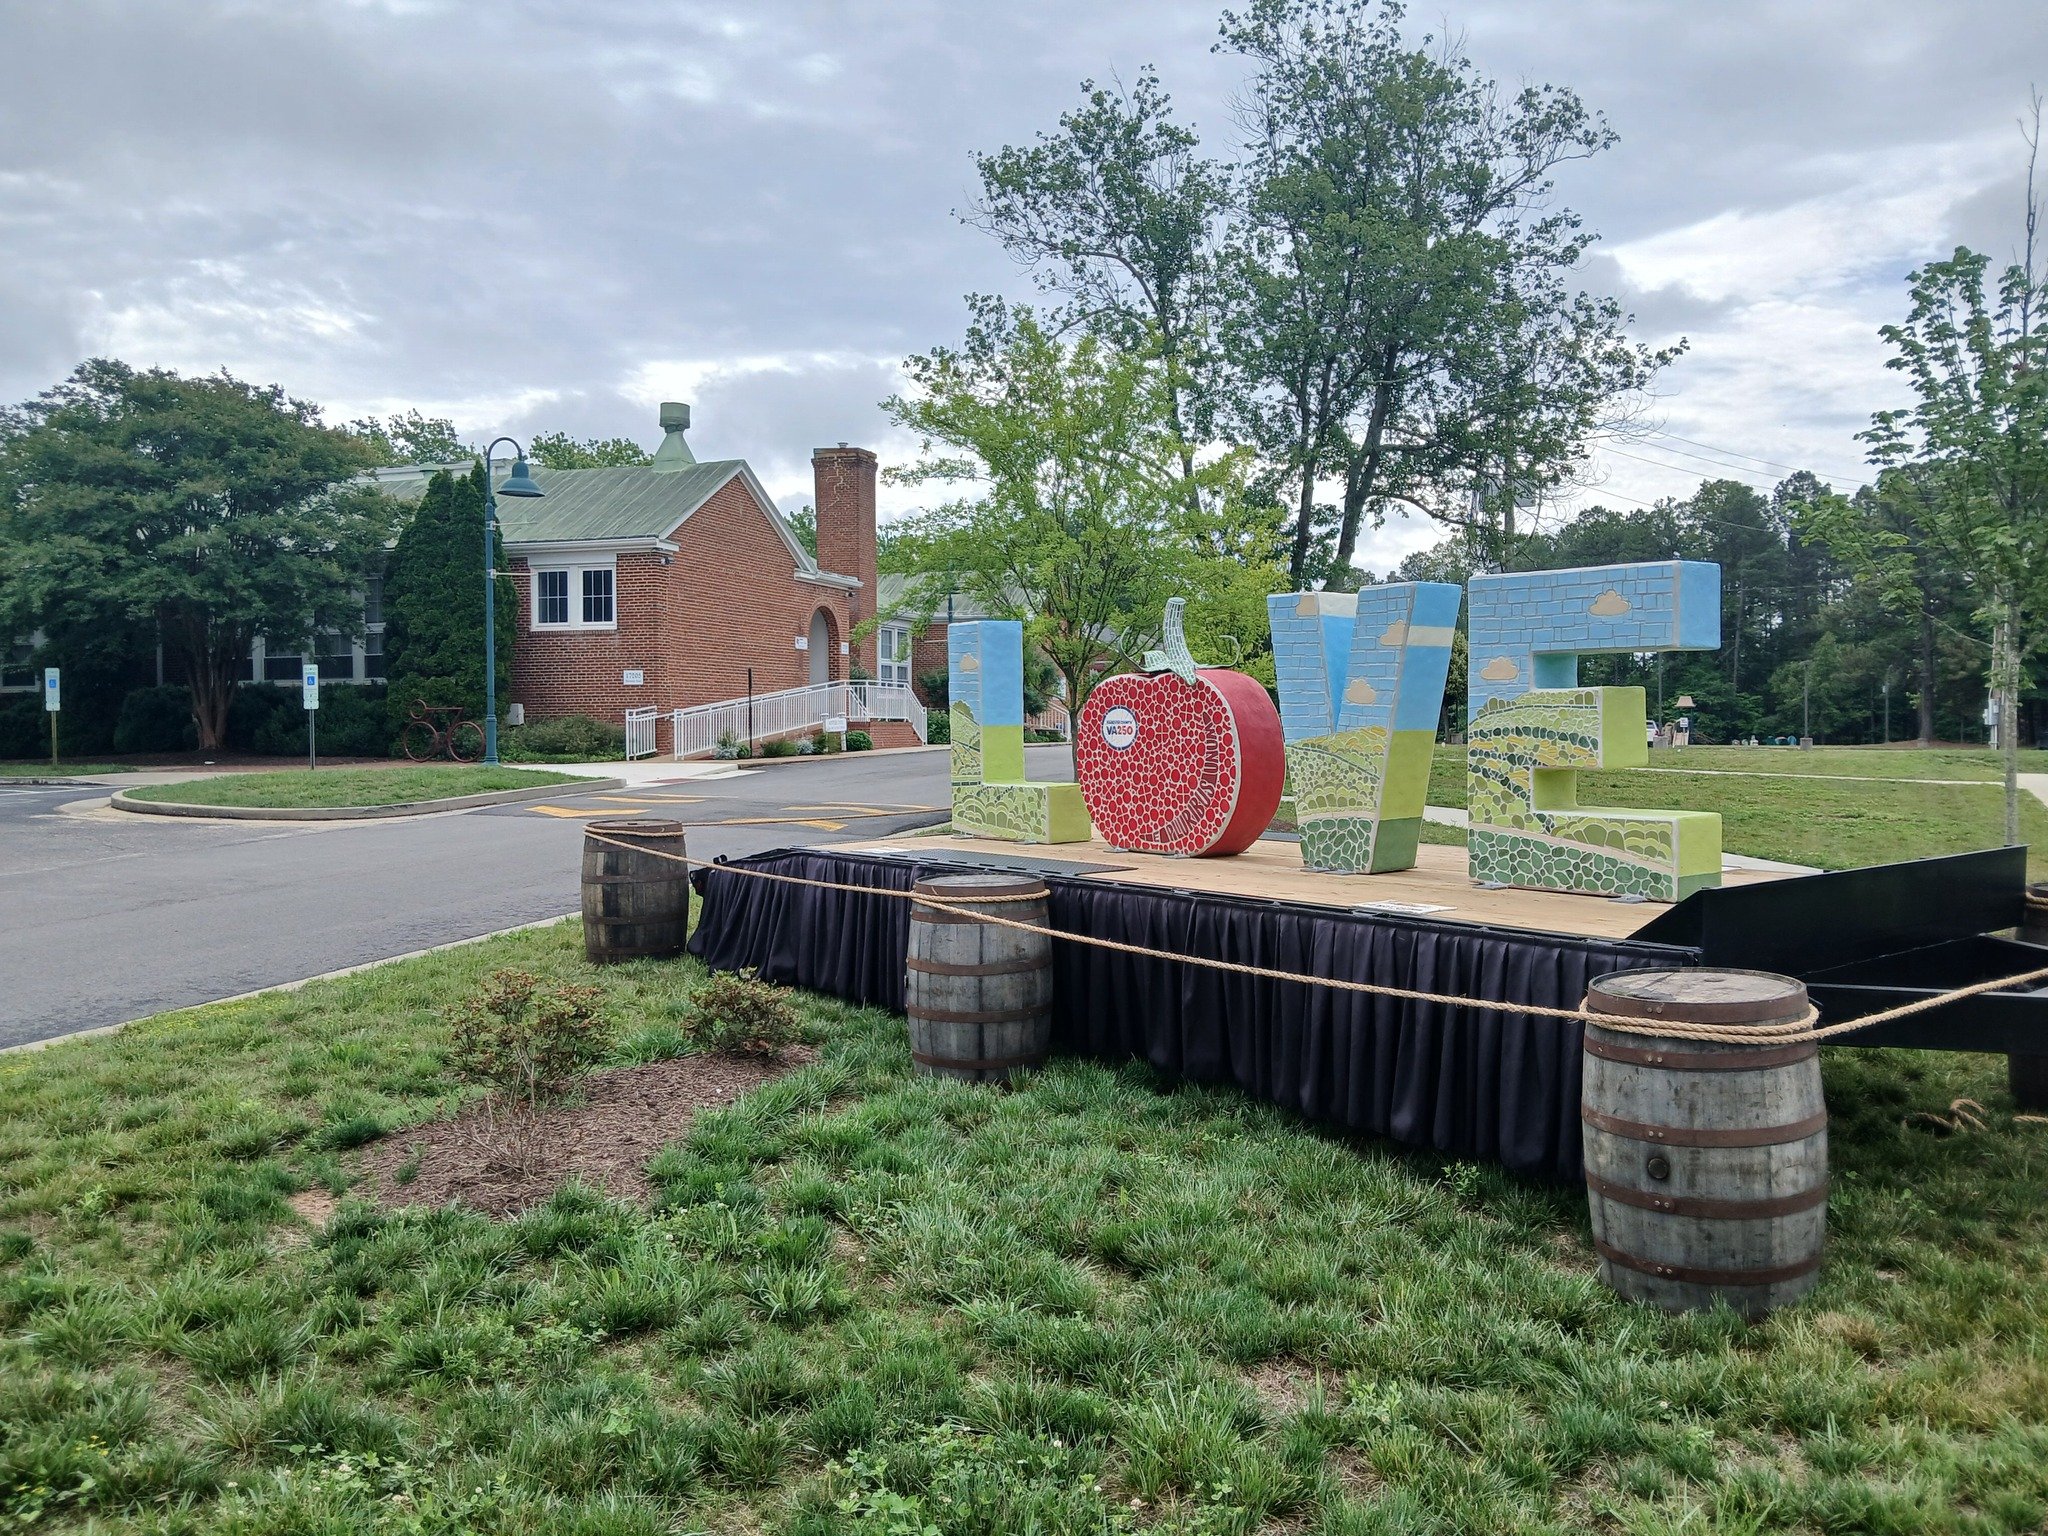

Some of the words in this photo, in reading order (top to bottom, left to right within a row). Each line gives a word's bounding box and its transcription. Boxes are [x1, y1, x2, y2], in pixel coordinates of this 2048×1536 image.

[1106, 725, 1133, 735] VA250
[1153, 831, 1160, 843] E
[1165, 780, 1215, 841] PLURIBUS
[1204, 722, 1219, 774] UNUM
